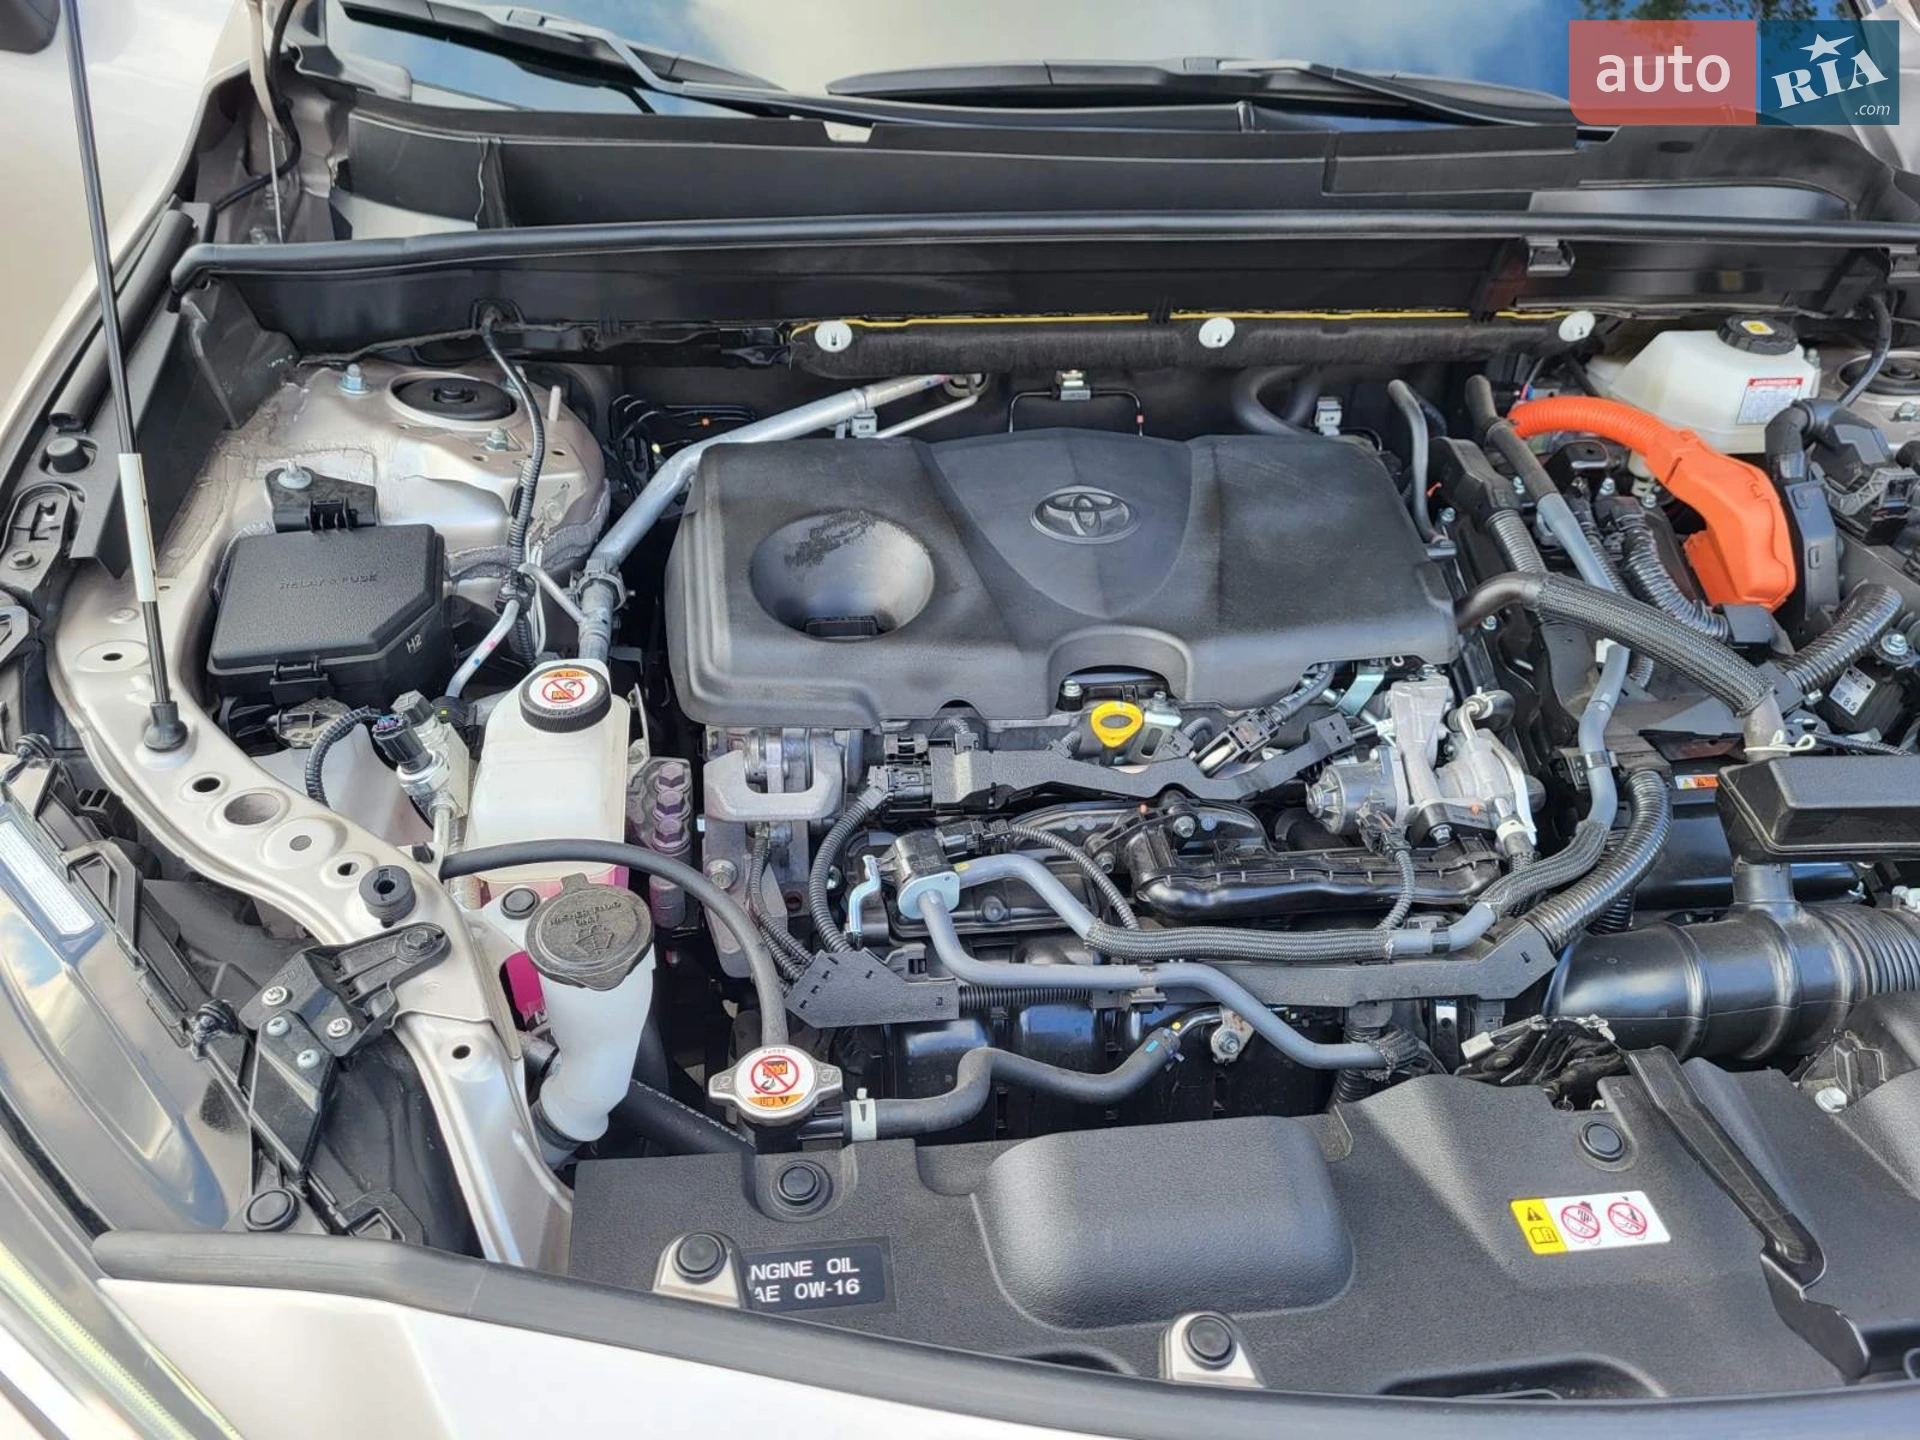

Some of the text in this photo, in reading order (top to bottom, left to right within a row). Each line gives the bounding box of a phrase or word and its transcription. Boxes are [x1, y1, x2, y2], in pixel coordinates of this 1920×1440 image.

[750, 1256, 860, 1281] NGINE OIL
[753, 1277, 860, 1303] AE 0W-16
